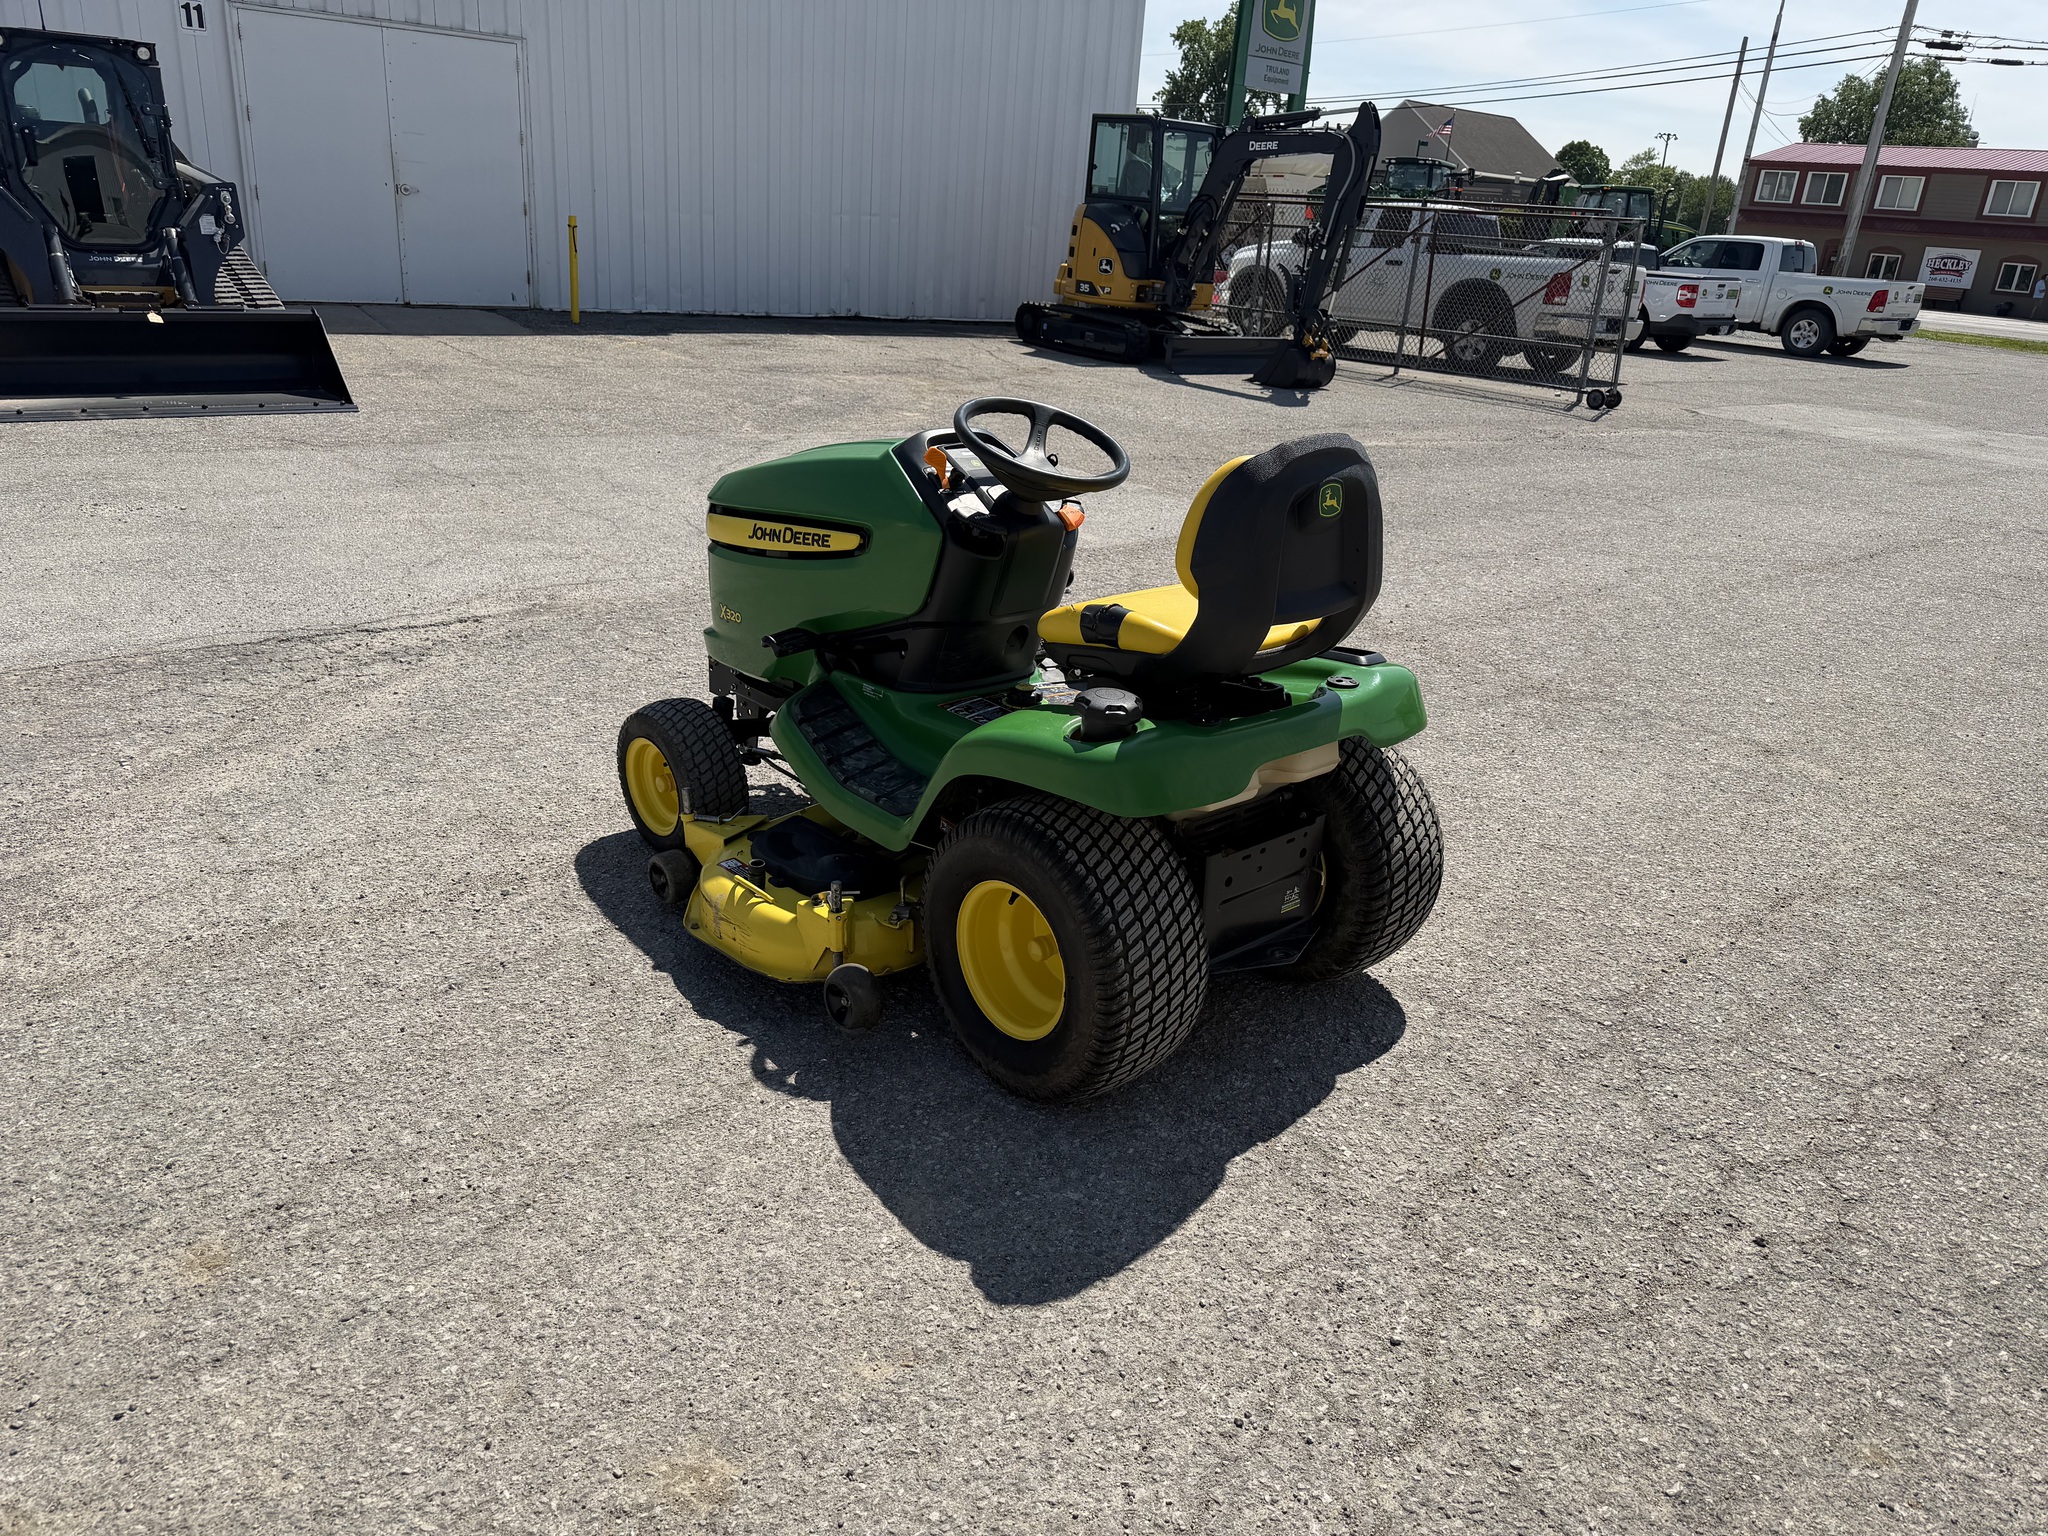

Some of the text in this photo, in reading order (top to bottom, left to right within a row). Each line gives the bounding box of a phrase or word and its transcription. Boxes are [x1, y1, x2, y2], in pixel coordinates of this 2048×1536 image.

[180, 2, 205, 29] 11
[1255, 44, 1301, 60] JOHN DEERE
[1265, 65, 1290, 76] TRULAND
[1263, 74, 1290, 86] Equipment
[1249, 140, 1279, 151] DEERE
[1927, 257, 1972, 271] HECKLEY
[1079, 283, 1090, 292] 35
[1659, 279, 1679, 287] DEERE
[1853, 289, 1872, 297] DEERE
[748, 523, 832, 548] JOHN DEERE
[719, 603, 742, 624] X320
